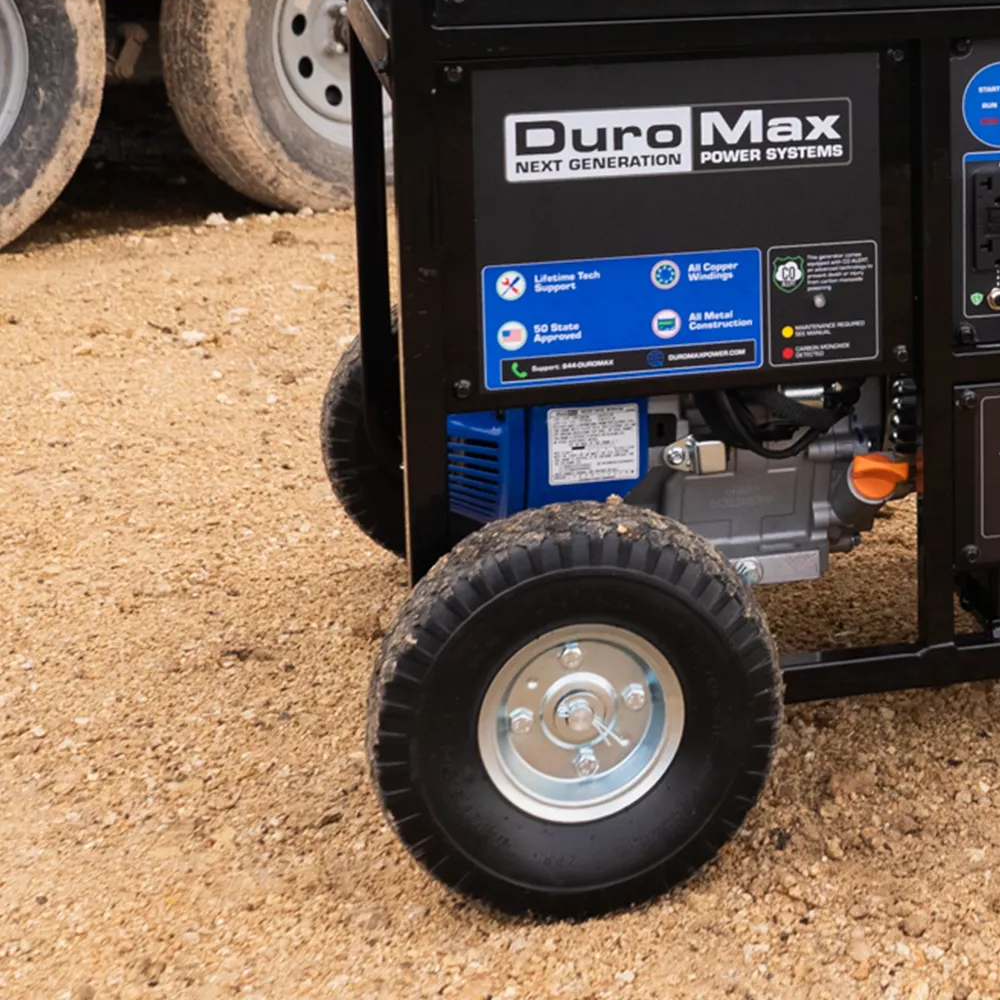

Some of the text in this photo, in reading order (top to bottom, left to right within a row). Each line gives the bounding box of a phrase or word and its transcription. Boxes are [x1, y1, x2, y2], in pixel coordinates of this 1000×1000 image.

[978, 85, 1000, 94] START
[515, 109, 841, 156] Duro Max
[515, 144, 843, 174] NEXT GENERATION POWER SYSTEMS
[688, 262, 738, 273] All Copper
[534, 270, 601, 283] Lifetime Tech
[688, 271, 734, 281] Windings
[534, 282, 576, 293] Support
[688, 310, 733, 321] All Metal
[533, 322, 580, 333] 50 State
[688, 318, 753, 330] Construction
[533, 331, 582, 344] Approved
